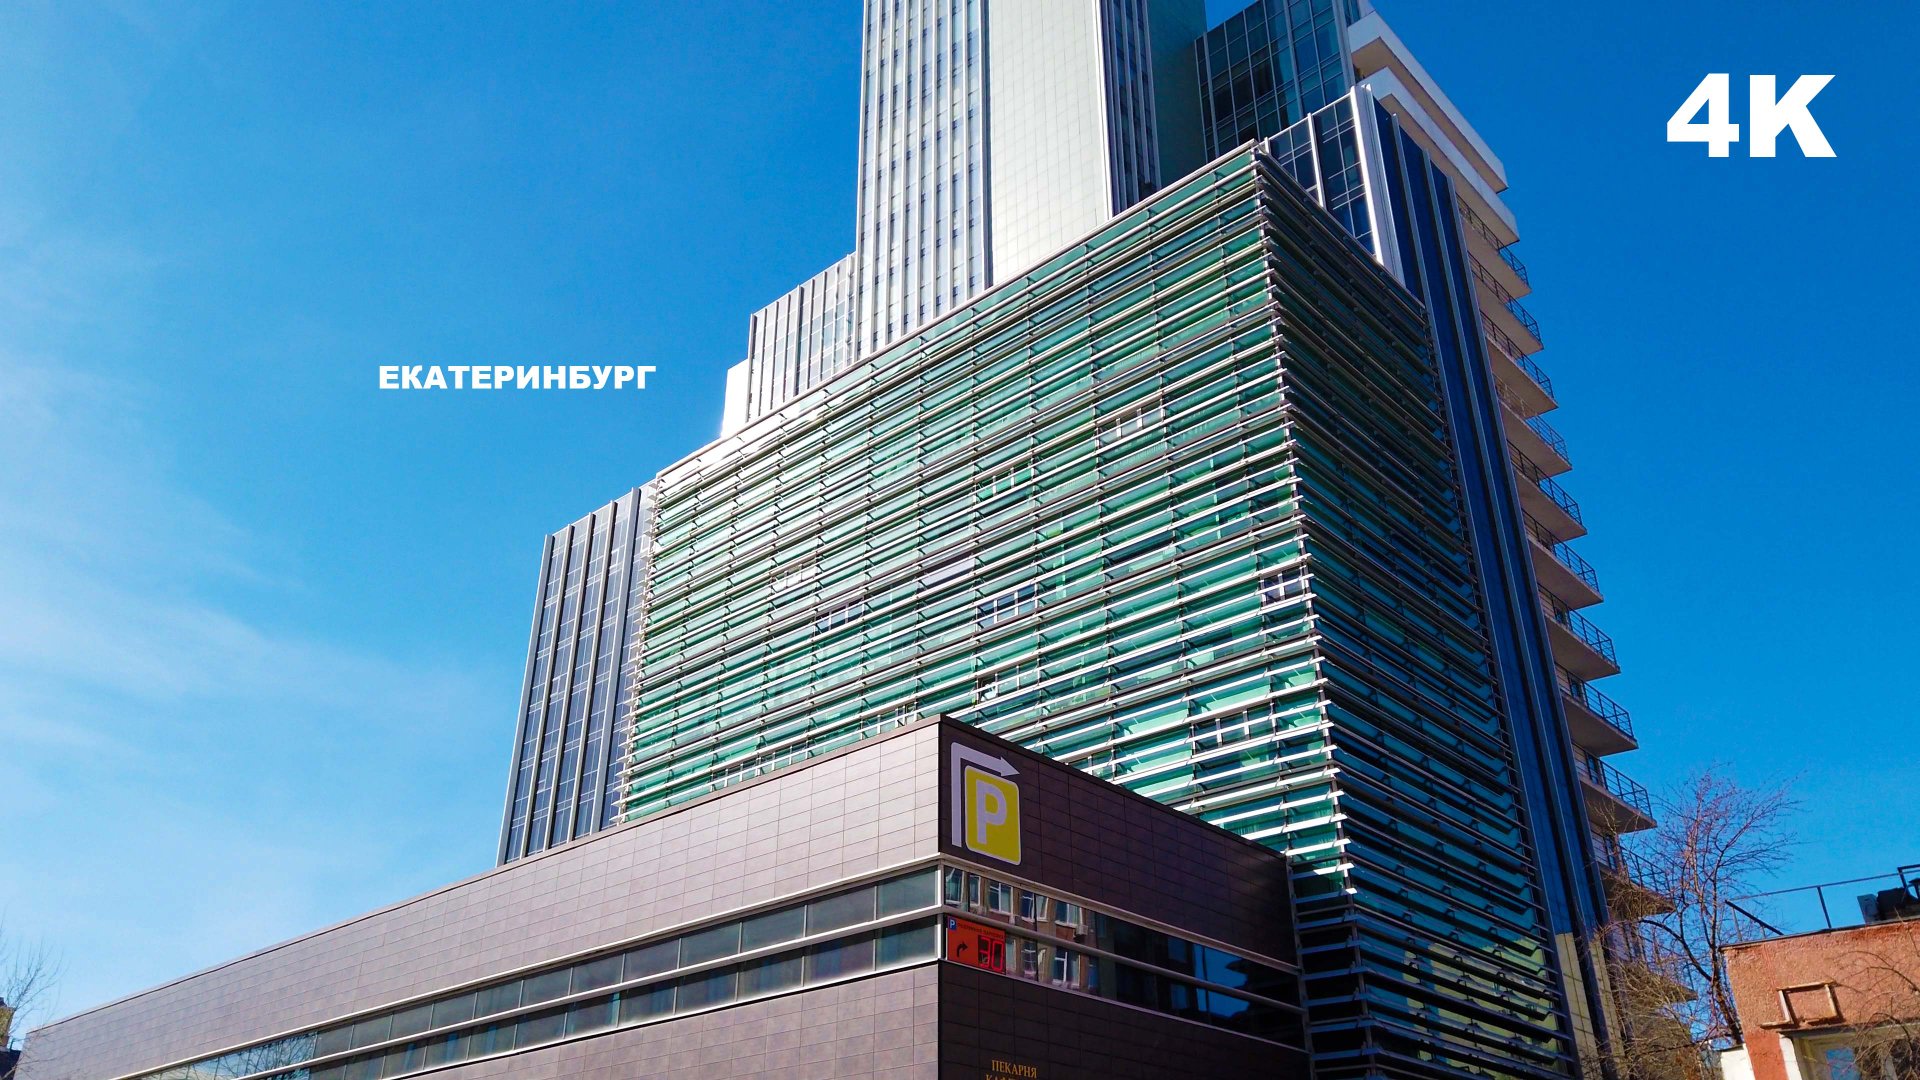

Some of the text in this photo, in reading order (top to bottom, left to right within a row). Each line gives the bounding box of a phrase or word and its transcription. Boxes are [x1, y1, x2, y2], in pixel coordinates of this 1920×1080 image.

[976, 779, 1007, 845] P
[949, 919, 956, 929] P
[991, 1059, 1038, 1079] ПЕКАРНЯ
